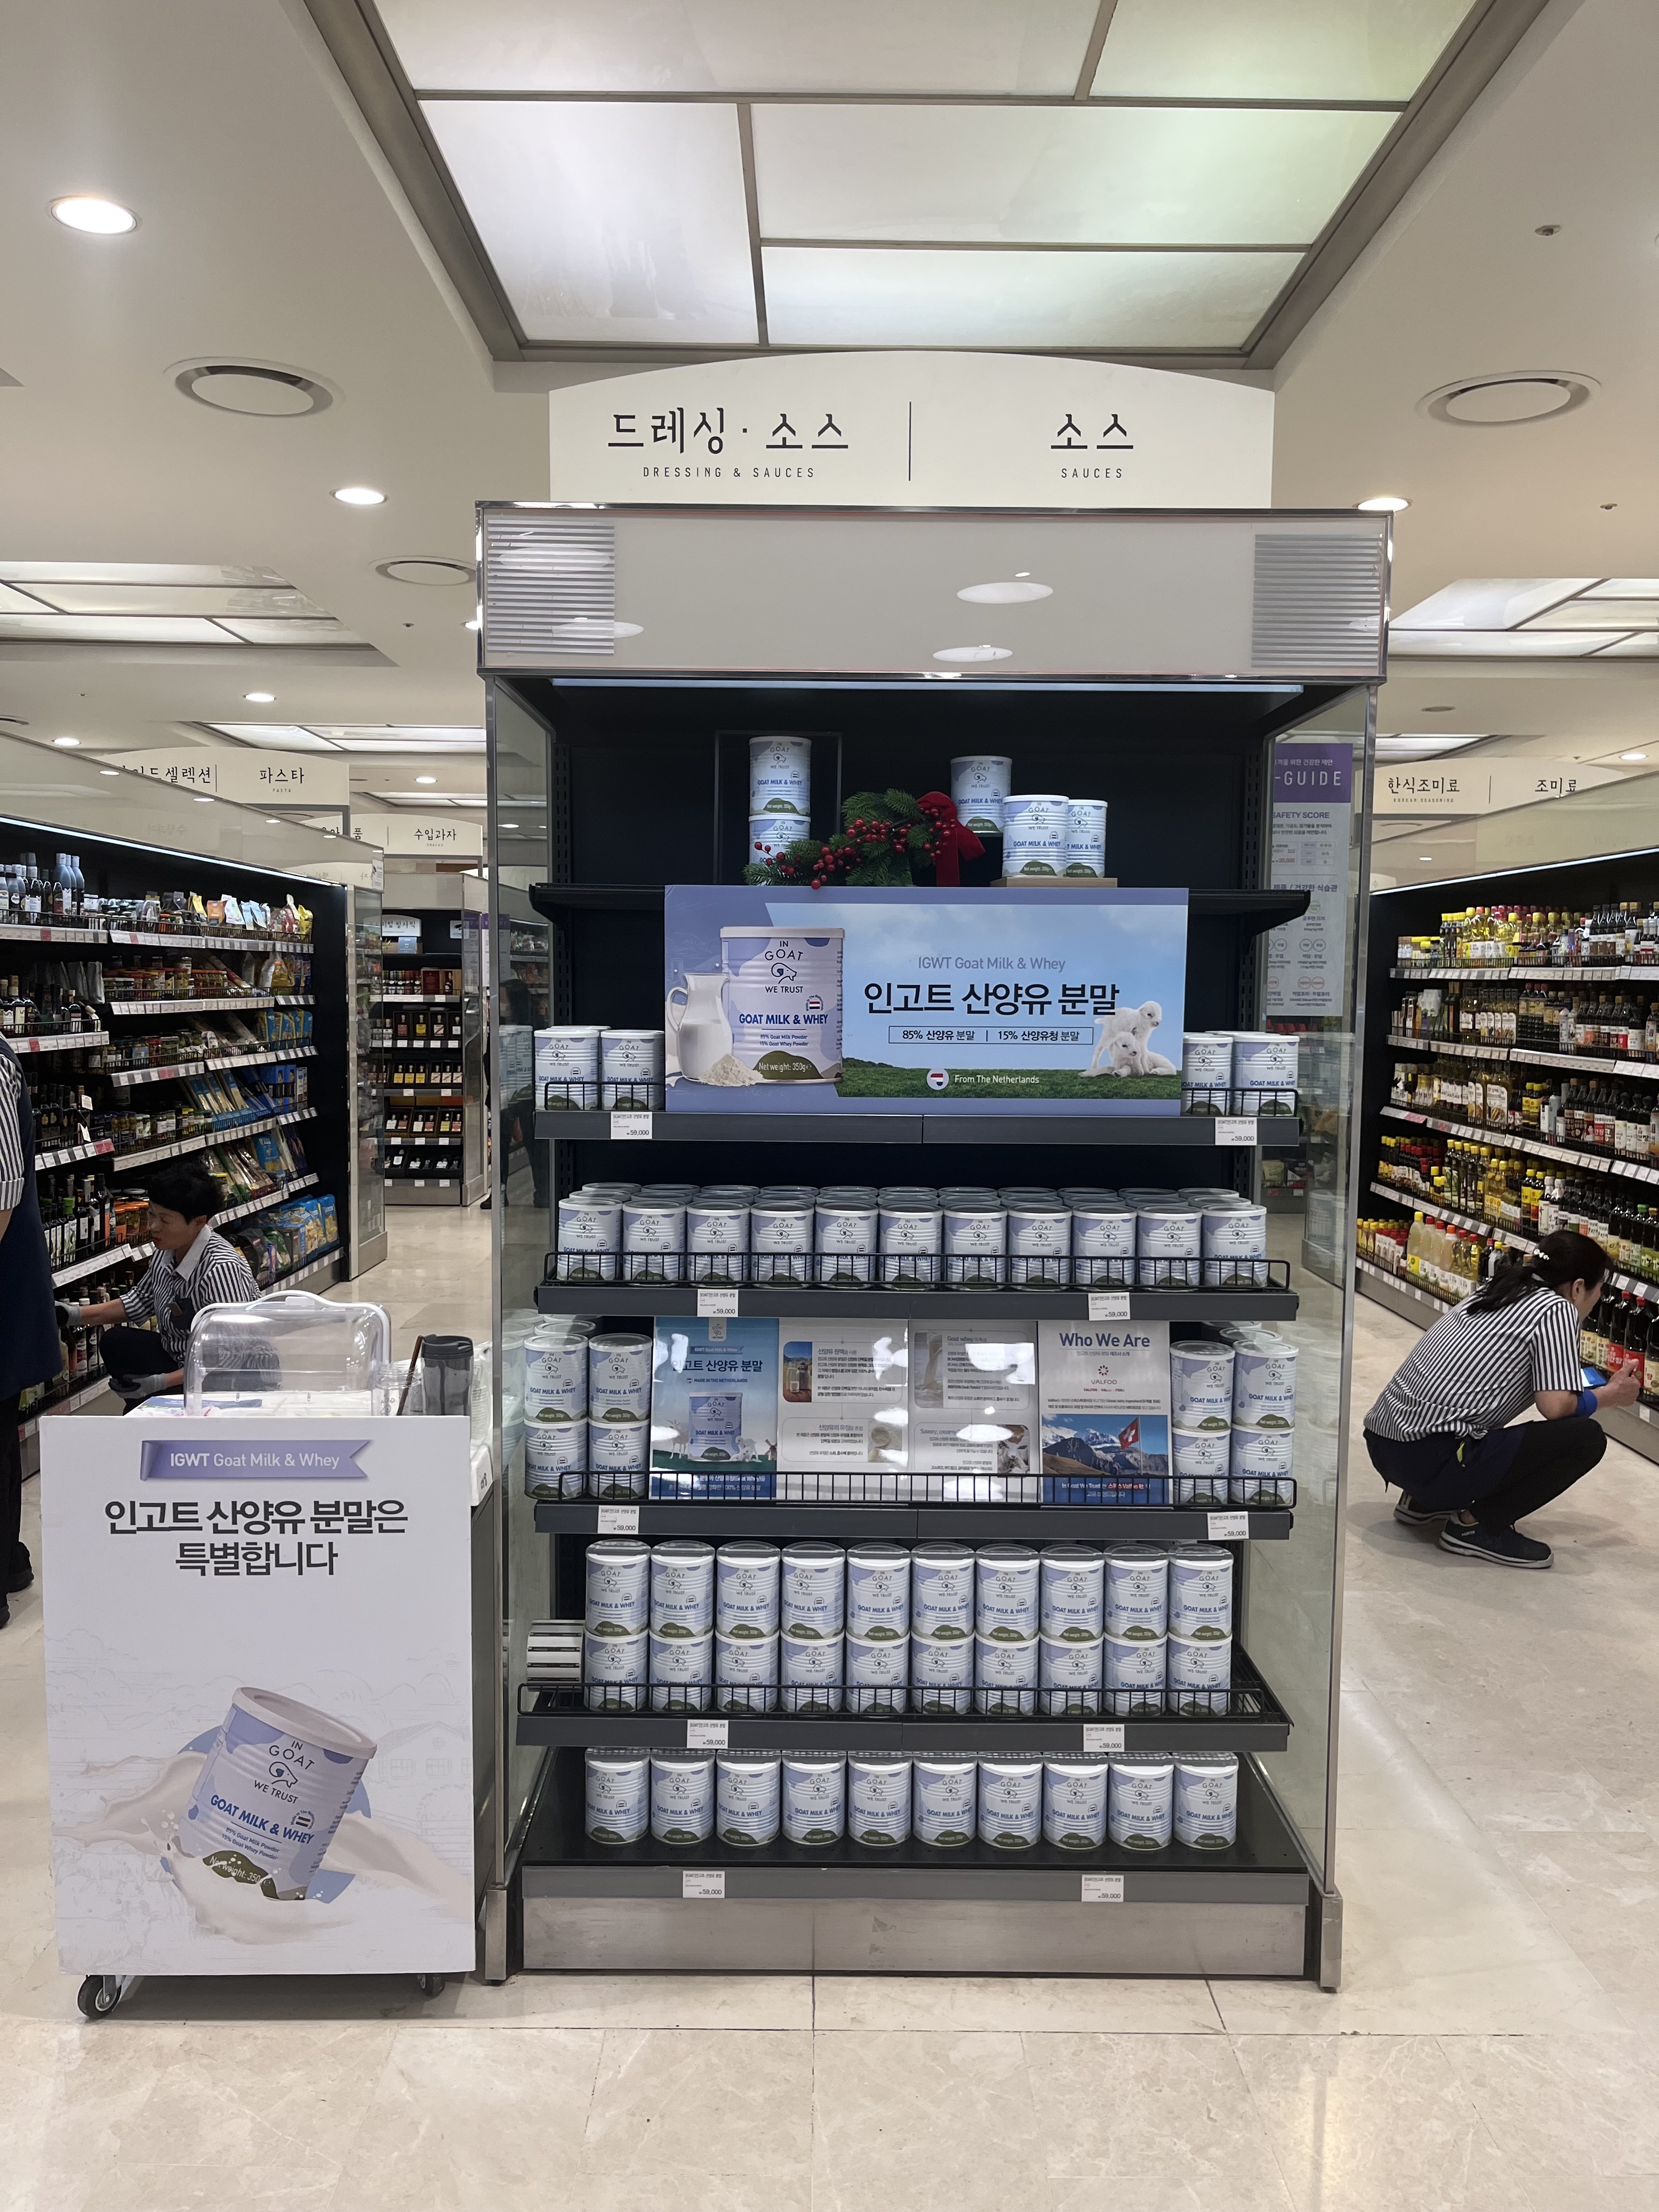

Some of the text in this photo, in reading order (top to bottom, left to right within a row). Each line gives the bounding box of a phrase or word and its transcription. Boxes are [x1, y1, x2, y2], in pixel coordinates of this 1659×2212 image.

[1051, 414, 1134, 449] 소스
[643, 467, 816, 478] DRESSING & SAUCES
[1060, 467, 1124, 478] SAUCES
[259, 767, 305, 784] 파스타
[1388, 776, 1460, 794] 한식조미료
[1535, 777, 1577, 794] 조미료
[414, 828, 457, 841] 수입과자
[1317, 884, 1338, 892] 식습관
[765, 949, 804, 961] GOAT
[918, 957, 1065, 973] IGWT Goat Milk & Whey
[864, 982, 1120, 1016] 인고트 산양유 분말
[739, 1013, 828, 1024] GOAT MILK & WHEY
[902, 1030, 975, 1041] 85% 산양유 분말
[997, 1030, 1080, 1041] 15% 산양유청 분말
[759, 1062, 769, 1070] Net
[769, 1062, 792, 1073] weight:
[954, 1074, 1040, 1084] From The Netherlands
[1059, 1332, 1150, 1347] Who We Are
[706, 1359, 738, 1372] 산양유
[741, 1360, 763, 1372] 분말
[170, 1453, 340, 1470] IGWT Goat Milk & Whey
[104, 1499, 409, 1534] 인고트 산양유 분말은
[175, 1541, 338, 1576] 특별합니다
[923, 1604, 938, 1612] GOAT
[957, 1603, 970, 1611] WHEY
[291, 1740, 303, 1751] IN
[269, 1745, 315, 1770] GOAT
[253, 1780, 299, 1804] WE TRUST
[657, 1805, 669, 1814] GOAT
[689, 1805, 704, 1815] WHEY
[1117, 1809, 1131, 1819] GOAT
[210, 1794, 240, 1817] GOAT
[238, 1810, 270, 1831] MILK
[269, 1823, 280, 1836] &
[283, 1826, 315, 1845] WHEY
[232, 1838, 244, 1848] Goat
[244, 1844, 259, 1855] Whey
[258, 1850, 279, 1861] Powder
[236, 1832, 249, 1842] Goat
[249, 1837, 260, 1847] Milk
[260, 1842, 280, 1853] Powder
